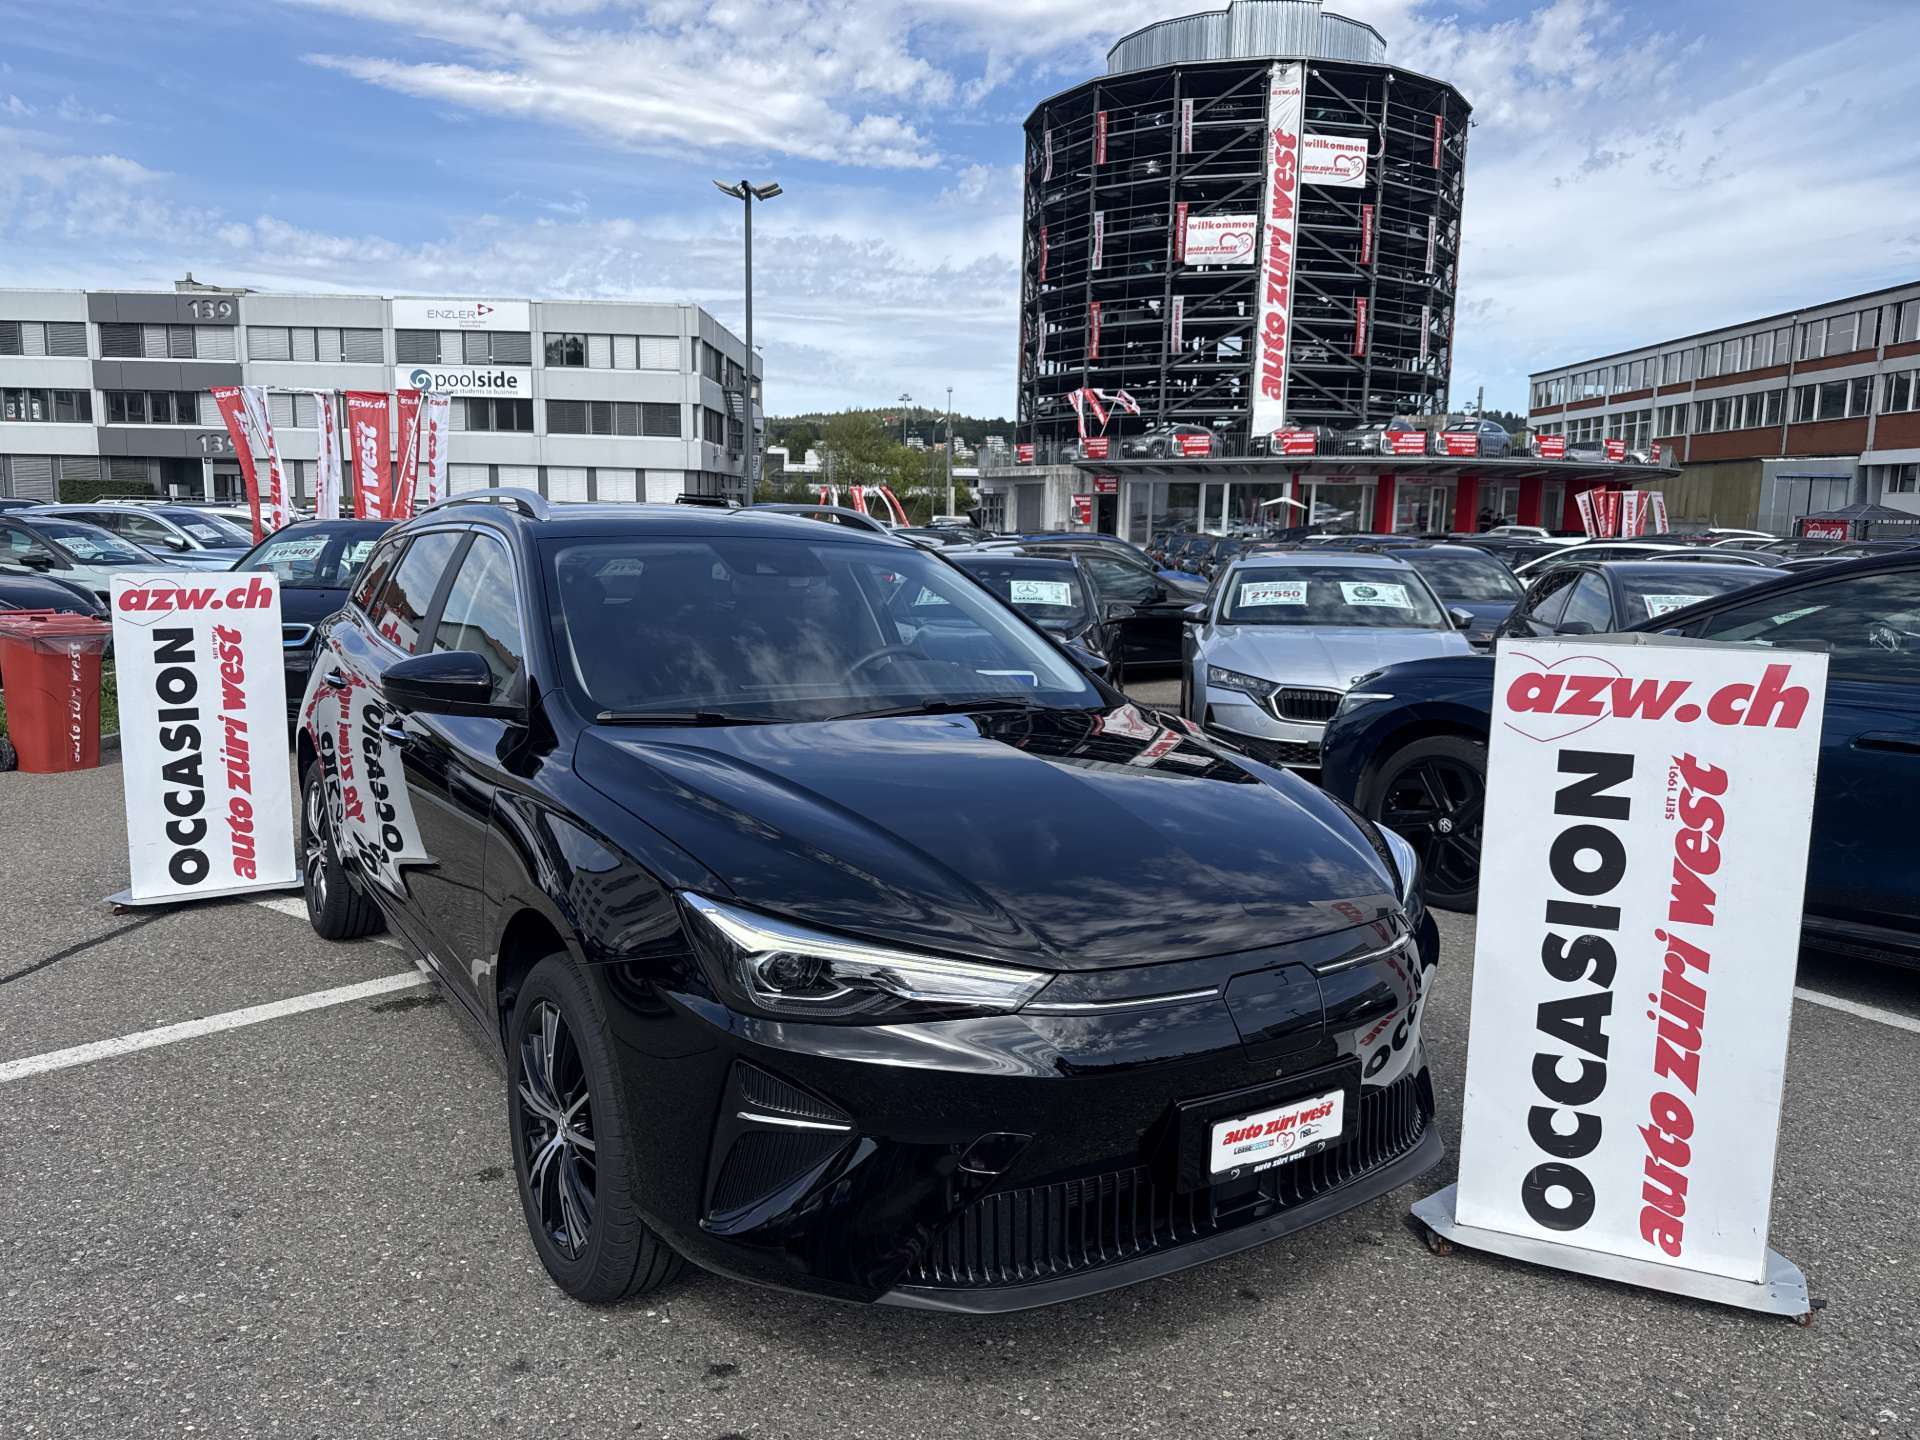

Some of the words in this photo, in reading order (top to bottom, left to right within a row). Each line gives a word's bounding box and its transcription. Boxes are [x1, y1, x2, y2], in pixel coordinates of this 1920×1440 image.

[1272, 128, 1297, 219] west
[1304, 139, 1366, 152] willkommen
[1189, 220, 1255, 229] willkommen
[1263, 224, 1292, 310] züri
[188, 300, 232, 319] 139
[427, 309, 476, 319] ENZLER
[435, 370, 518, 390] poolside
[1261, 311, 1286, 400] auto
[348, 399, 387, 409] azw.ch
[359, 421, 379, 488] west
[118, 578, 273, 611] azw.ch
[211, 623, 247, 712] west
[1506, 663, 1811, 730] azw.ch
[152, 627, 209, 886] OCCASION
[217, 715, 252, 795] züri
[1668, 764, 1679, 792] 1991
[225, 796, 257, 880] auto
[1665, 796, 1676, 821] SEIT
[1667, 752, 1729, 927] west
[1521, 749, 1636, 1232] OCCASION
[1647, 928, 1711, 1097] züri
[1222, 1123, 1263, 1146] auto
[1264, 1110, 1299, 1136] züri
[1299, 1101, 1334, 1125] west
[1253, 1162, 1272, 1173] auto
[1289, 1149, 1307, 1161] west
[1636, 1091, 1695, 1258] auto
